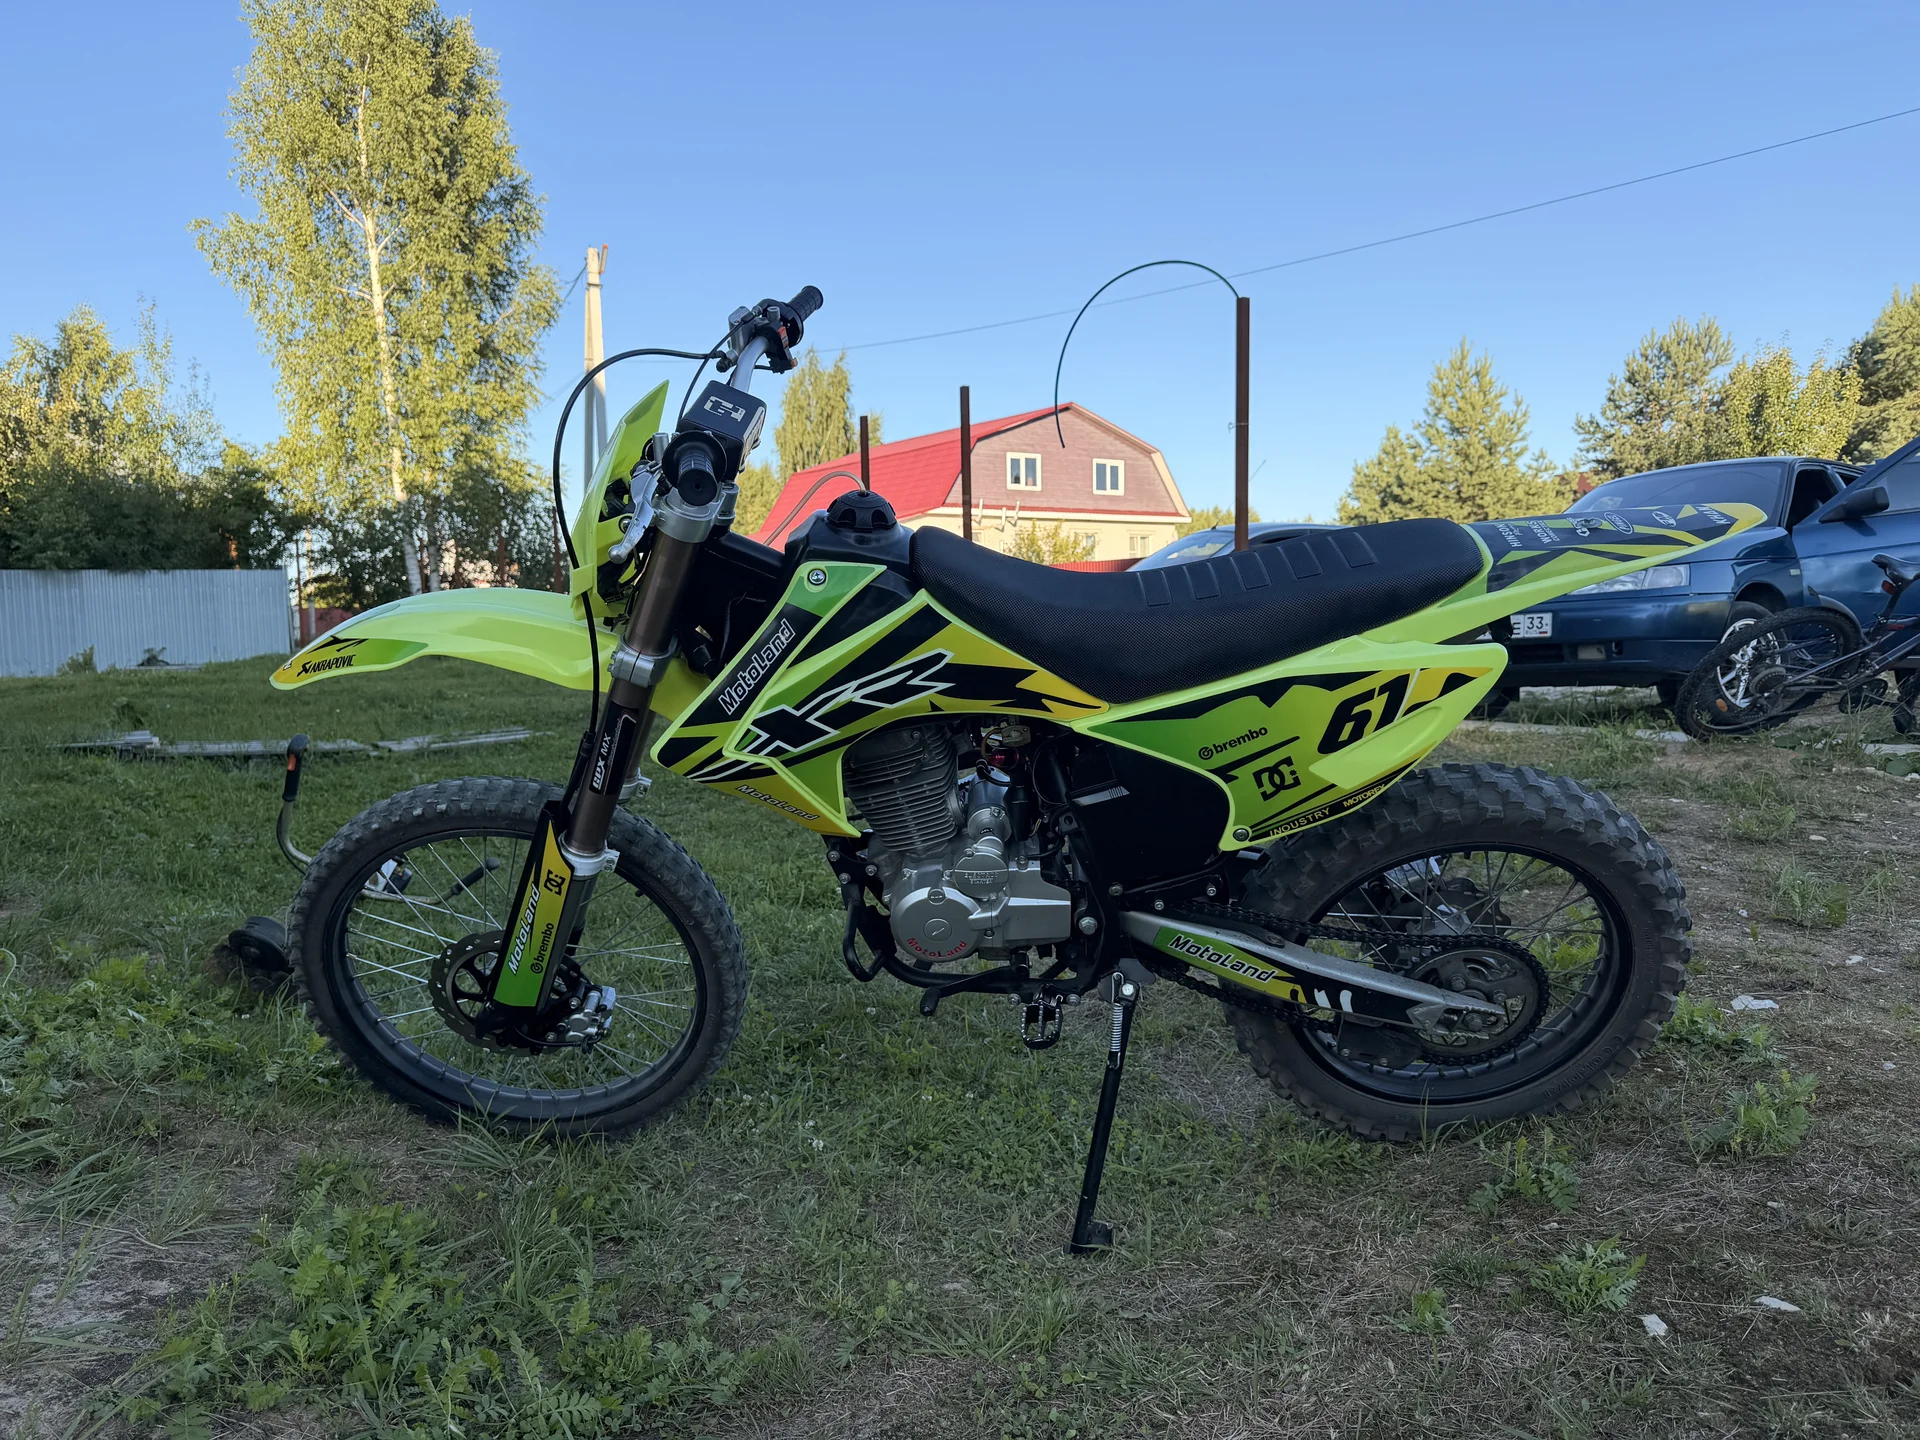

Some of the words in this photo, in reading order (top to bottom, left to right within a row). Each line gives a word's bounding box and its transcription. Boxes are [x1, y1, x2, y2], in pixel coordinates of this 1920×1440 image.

[1495, 523, 1523, 547] HINSON
[1526, 520, 1552, 544] WORKS
[1527, 617, 1544, 630] 33
[718, 618, 796, 715] MotoLand
[600, 732, 612, 756] MX
[1212, 727, 1268, 754] brembo
[736, 784, 820, 821] MotoLand
[1342, 783, 1386, 808] MOTOREX
[508, 882, 540, 976] MotoLand
[533, 922, 555, 961] brembo
[906, 937, 968, 959] MotoLand
[1167, 933, 1278, 983] MotoLand
